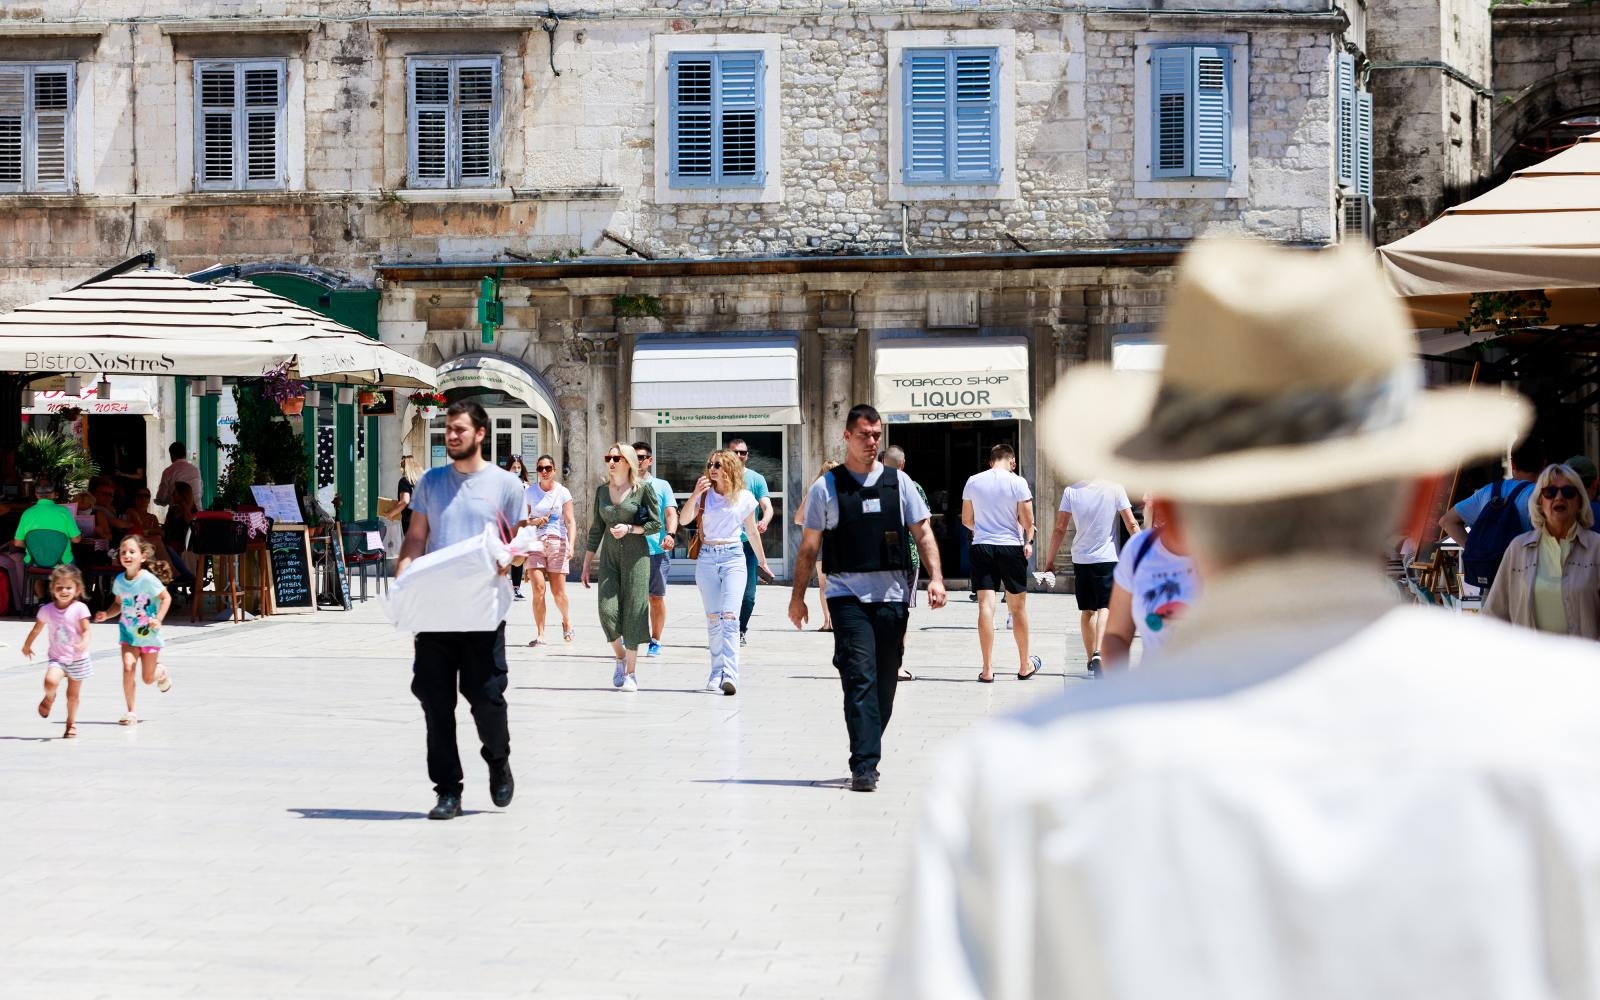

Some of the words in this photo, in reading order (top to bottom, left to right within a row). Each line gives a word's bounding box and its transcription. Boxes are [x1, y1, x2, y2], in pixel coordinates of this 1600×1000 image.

[892, 377, 963, 388] TOBACCO
[967, 375, 1009, 386] SHOP
[911, 390, 991, 407] LIQUOR
[95, 403, 128, 412] NORA
[918, 411, 982, 421] TOBACCO
